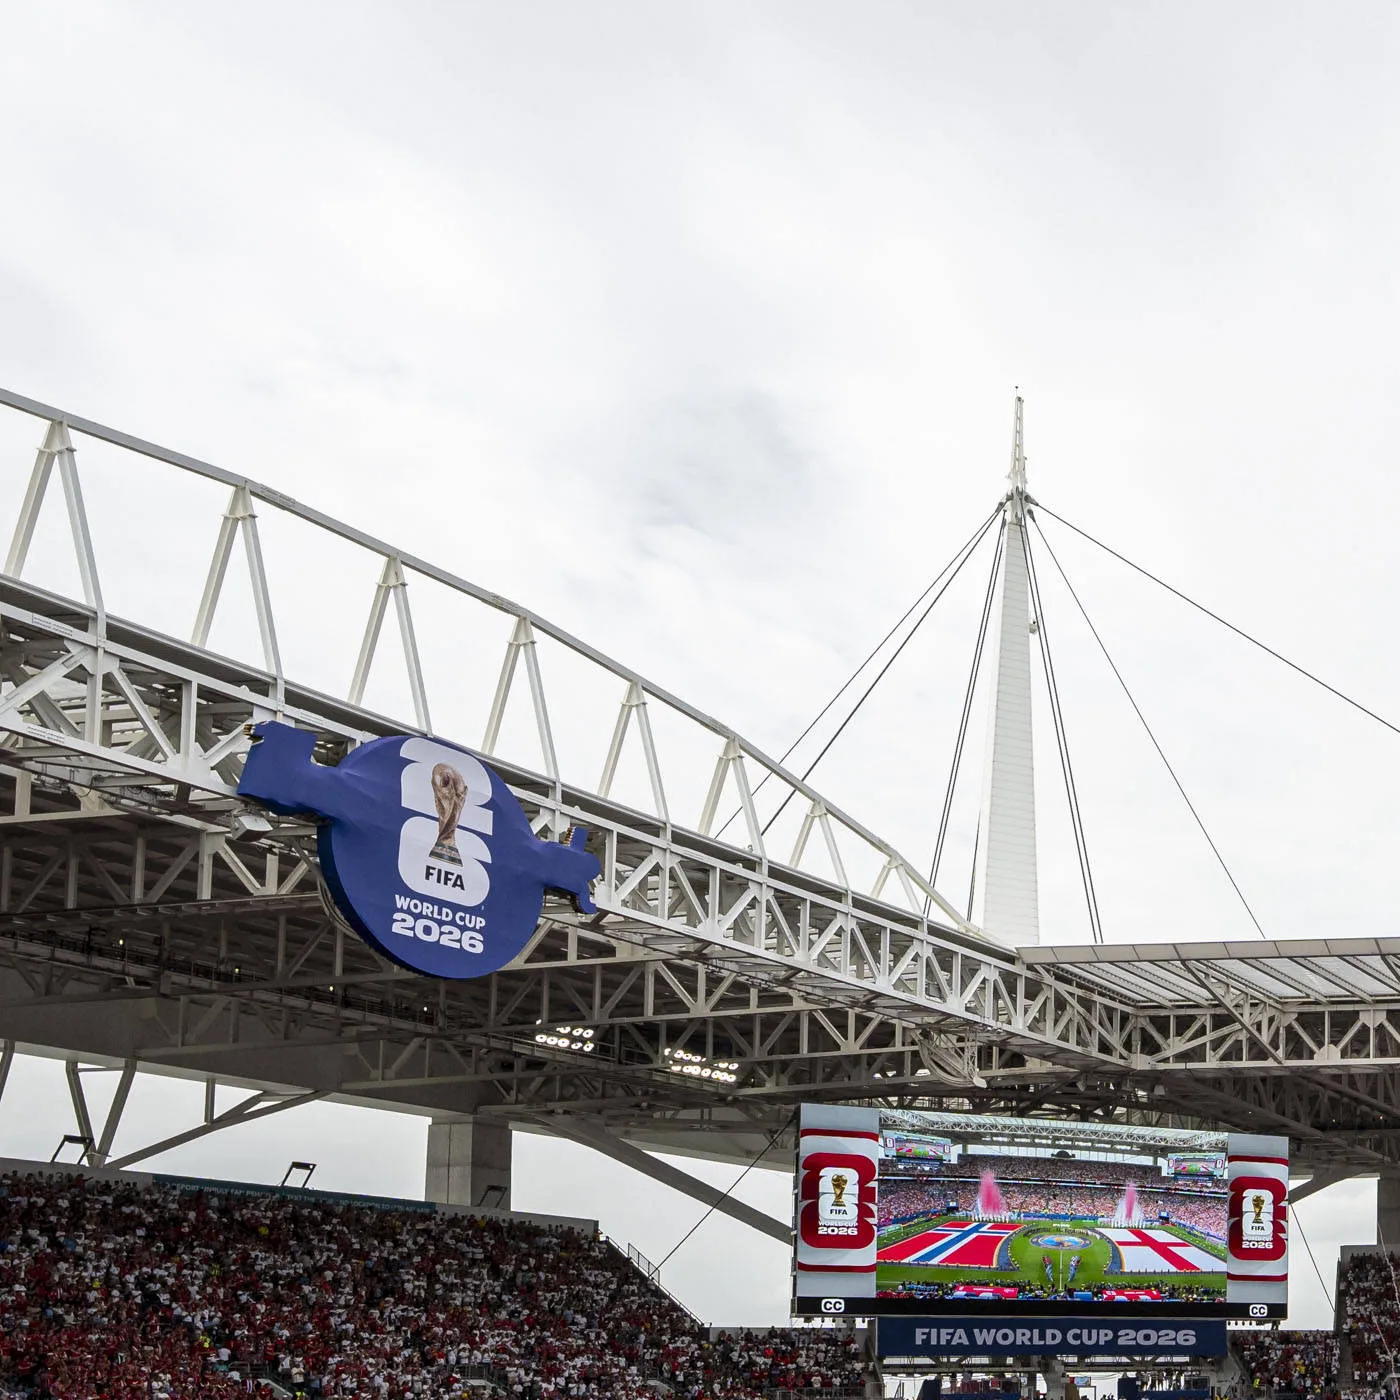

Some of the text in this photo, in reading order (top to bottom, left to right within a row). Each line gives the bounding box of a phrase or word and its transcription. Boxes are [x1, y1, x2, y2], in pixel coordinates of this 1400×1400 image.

[424, 864, 466, 891] FIFA
[394, 894, 487, 930] WORLD CUP
[391, 913, 484, 954] 2026
[818, 1227, 858, 1235] 2026
[1242, 1241, 1273, 1249] 2026
[823, 1301, 843, 1311] CC
[1250, 1306, 1267, 1315] CC
[915, 1327, 1197, 1347] FIFA WORLD CUP 2026
